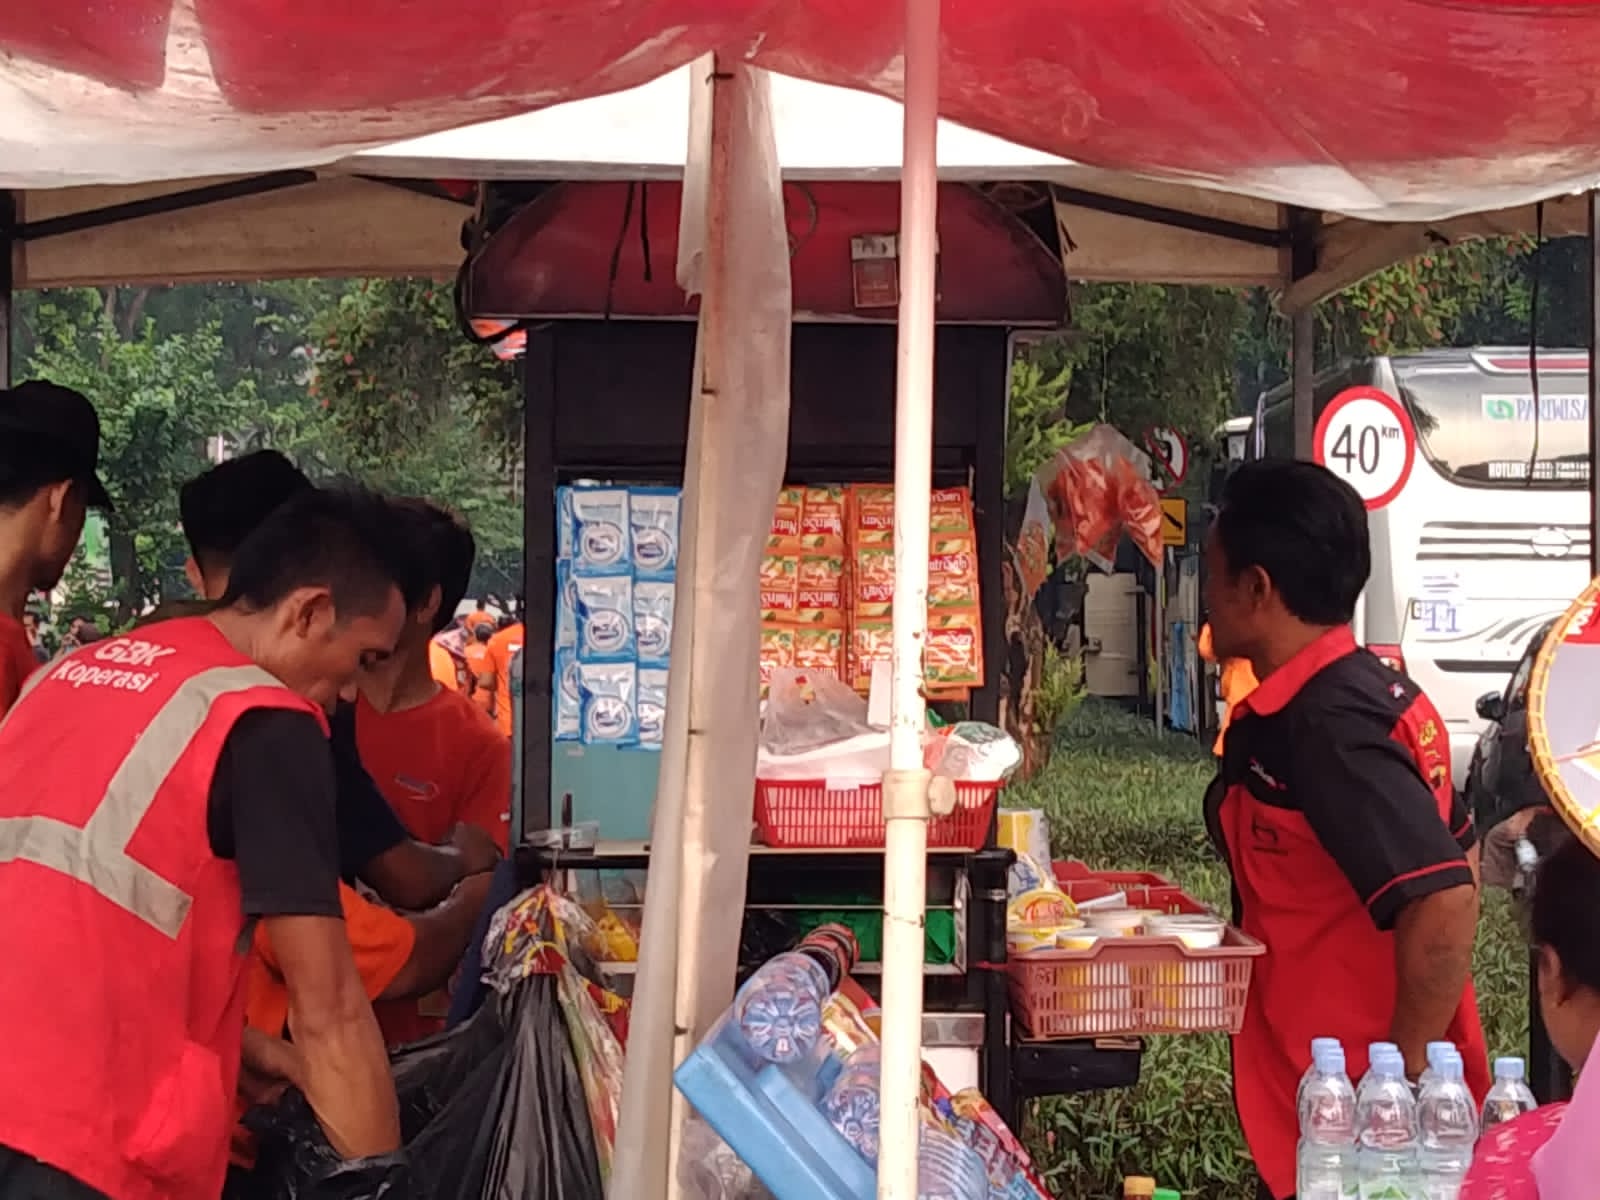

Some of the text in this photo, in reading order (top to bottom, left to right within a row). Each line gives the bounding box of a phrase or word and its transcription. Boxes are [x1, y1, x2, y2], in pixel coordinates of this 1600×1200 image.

[1331, 424, 1399, 474] 40 km
[95, 638, 177, 666] GBK
[50, 659, 160, 692] Koperasi
